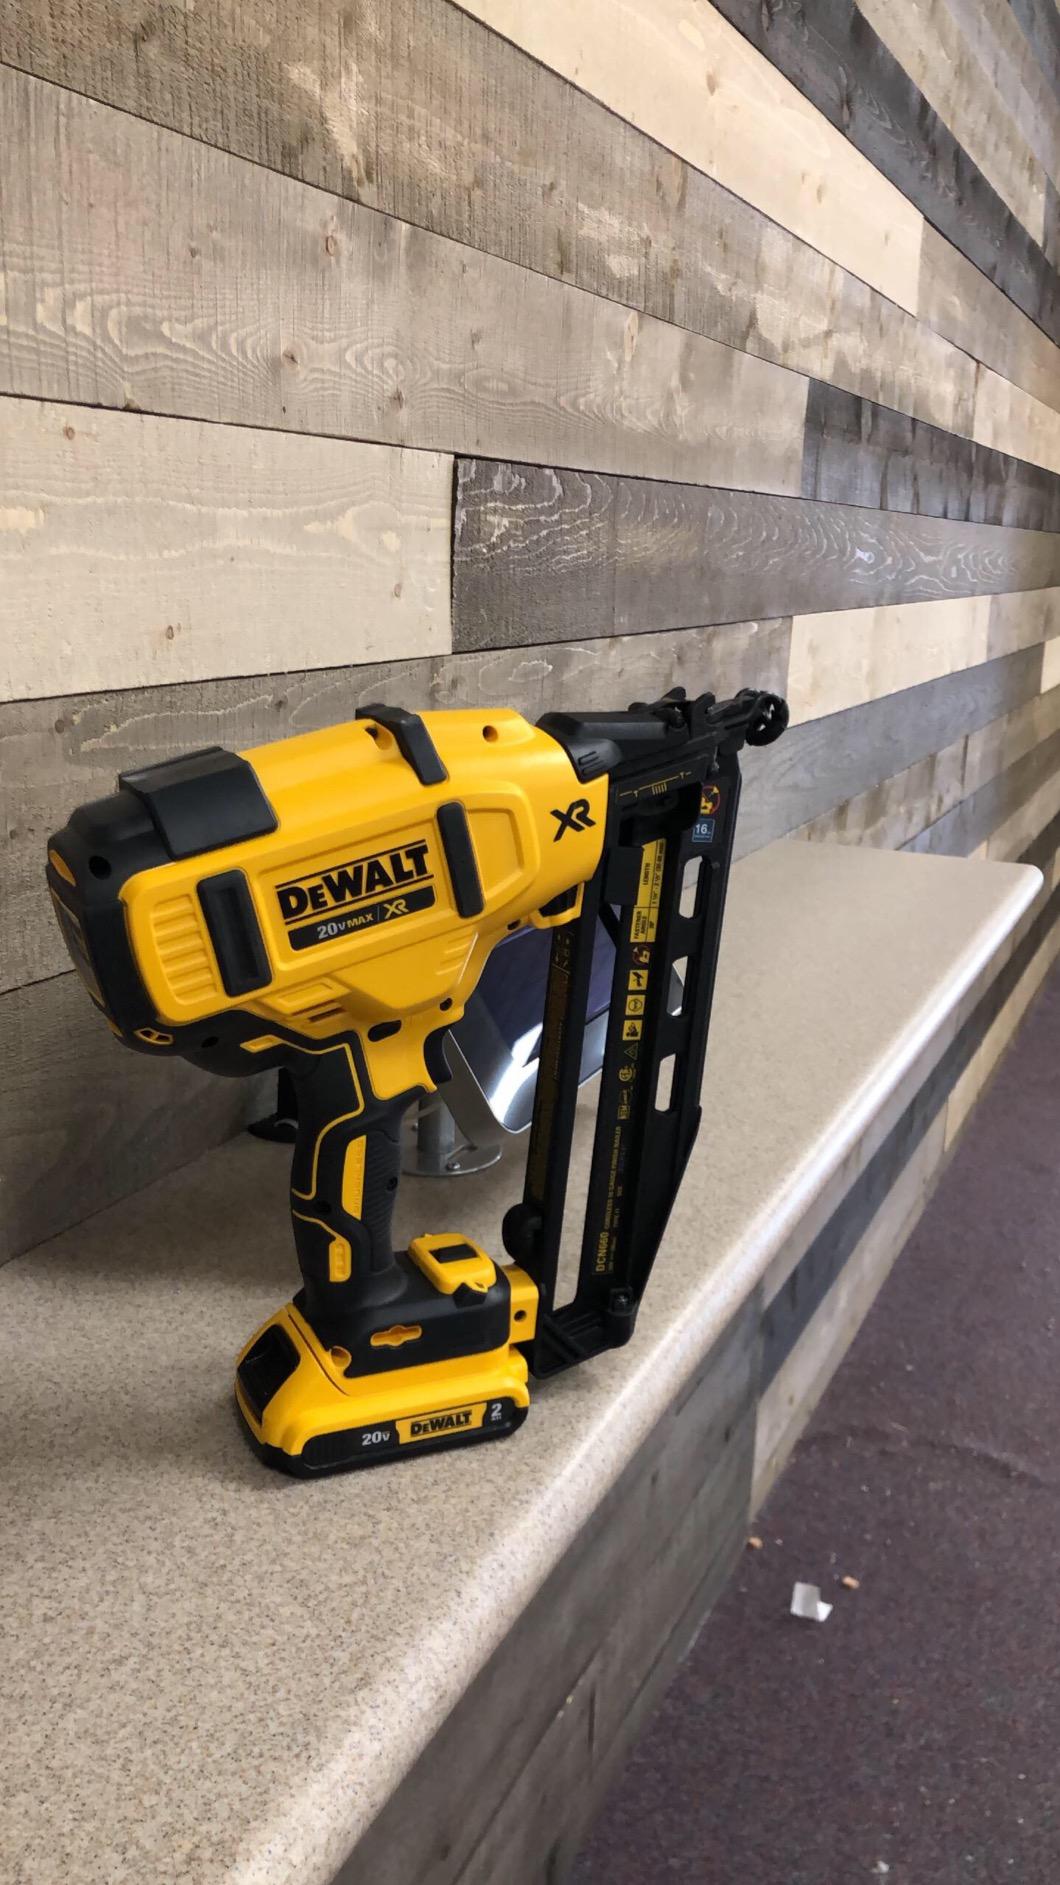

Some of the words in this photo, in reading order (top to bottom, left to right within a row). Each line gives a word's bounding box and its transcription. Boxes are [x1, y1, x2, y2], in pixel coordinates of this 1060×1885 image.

[550, 799, 596, 843] XR
[695, 823, 708, 835] 16
[276, 844, 429, 921] DEWALT
[346, 913, 374, 928] MAX
[384, 899, 409, 920] XR
[595, 1231, 609, 1272] DCN660
[491, 1403, 502, 1417] 2
[410, 1411, 472, 1435] DEWALT
